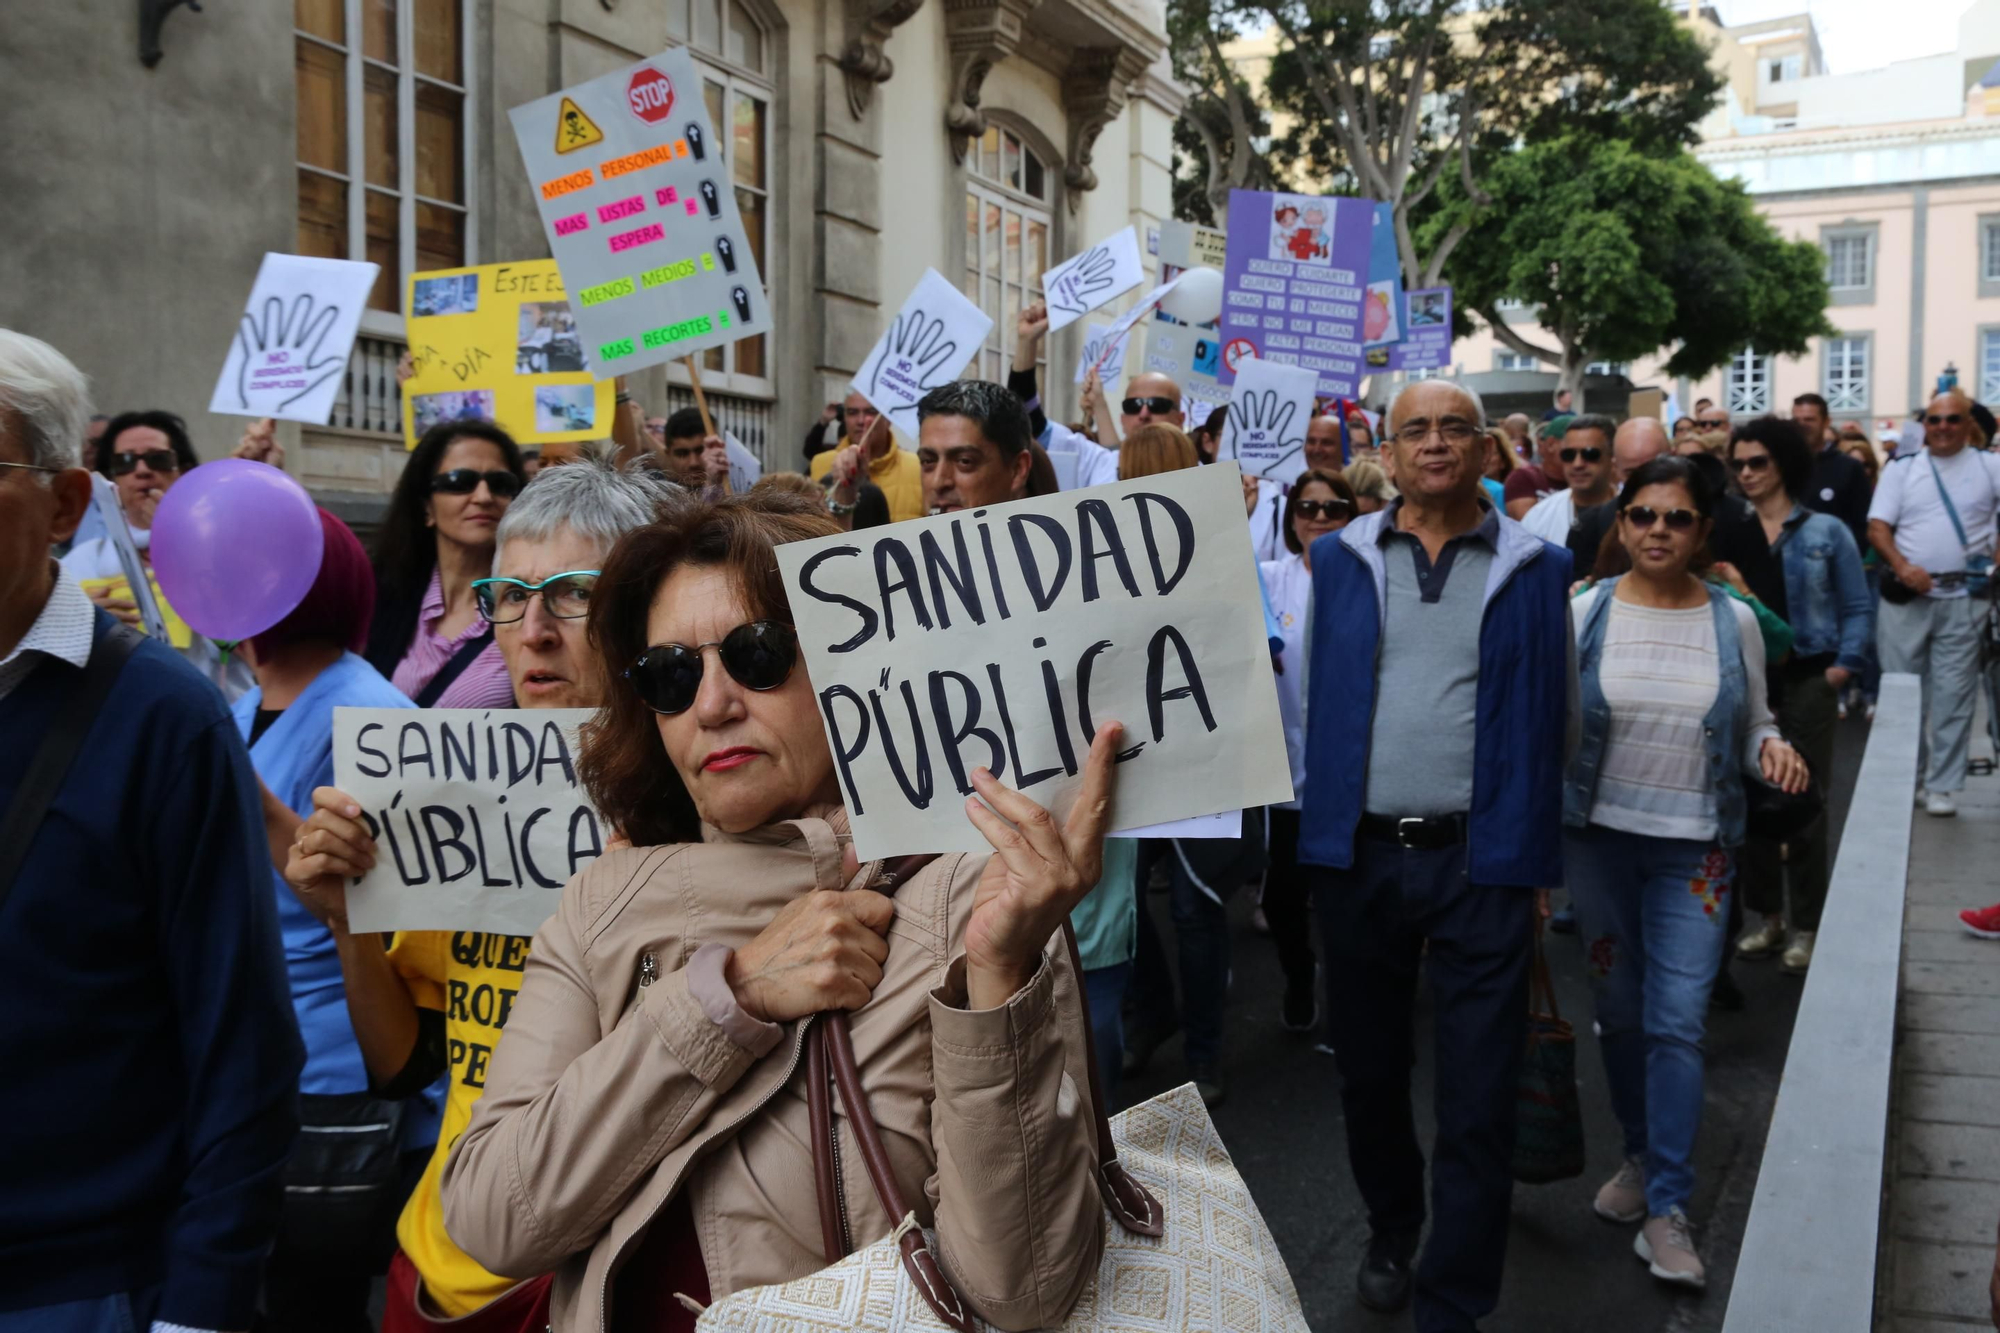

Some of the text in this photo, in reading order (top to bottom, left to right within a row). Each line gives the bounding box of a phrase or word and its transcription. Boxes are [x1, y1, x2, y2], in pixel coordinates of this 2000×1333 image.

[630, 78, 670, 113] STOP
[542, 172, 593, 198] MENOS
[601, 146, 671, 178] PERSONAL
[555, 188, 675, 235] MAS LISTAS DE
[610, 225, 664, 251] ESPERA
[1251, 261, 1290, 274] QUIERO
[495, 268, 540, 293] ESTE
[580, 279, 633, 305] MENOS
[641, 261, 696, 287] MEDIOS
[1243, 276, 1358, 299] QUIERO PROTEGERTE
[1229, 293, 1262, 306] COMO
[601, 341, 633, 361] MAS
[643, 317, 712, 346] RECORTES
[1266, 317, 1282, 328] NO
[1317, 323, 1353, 337] DEJAN
[1266, 335, 1359, 354] FALTA PERSONAL
[896, 359, 912, 373] NO
[1302, 355, 1354, 371] MATERIAL
[1250, 432, 1265, 441] NO
[356, 711, 592, 789] SANIDA
